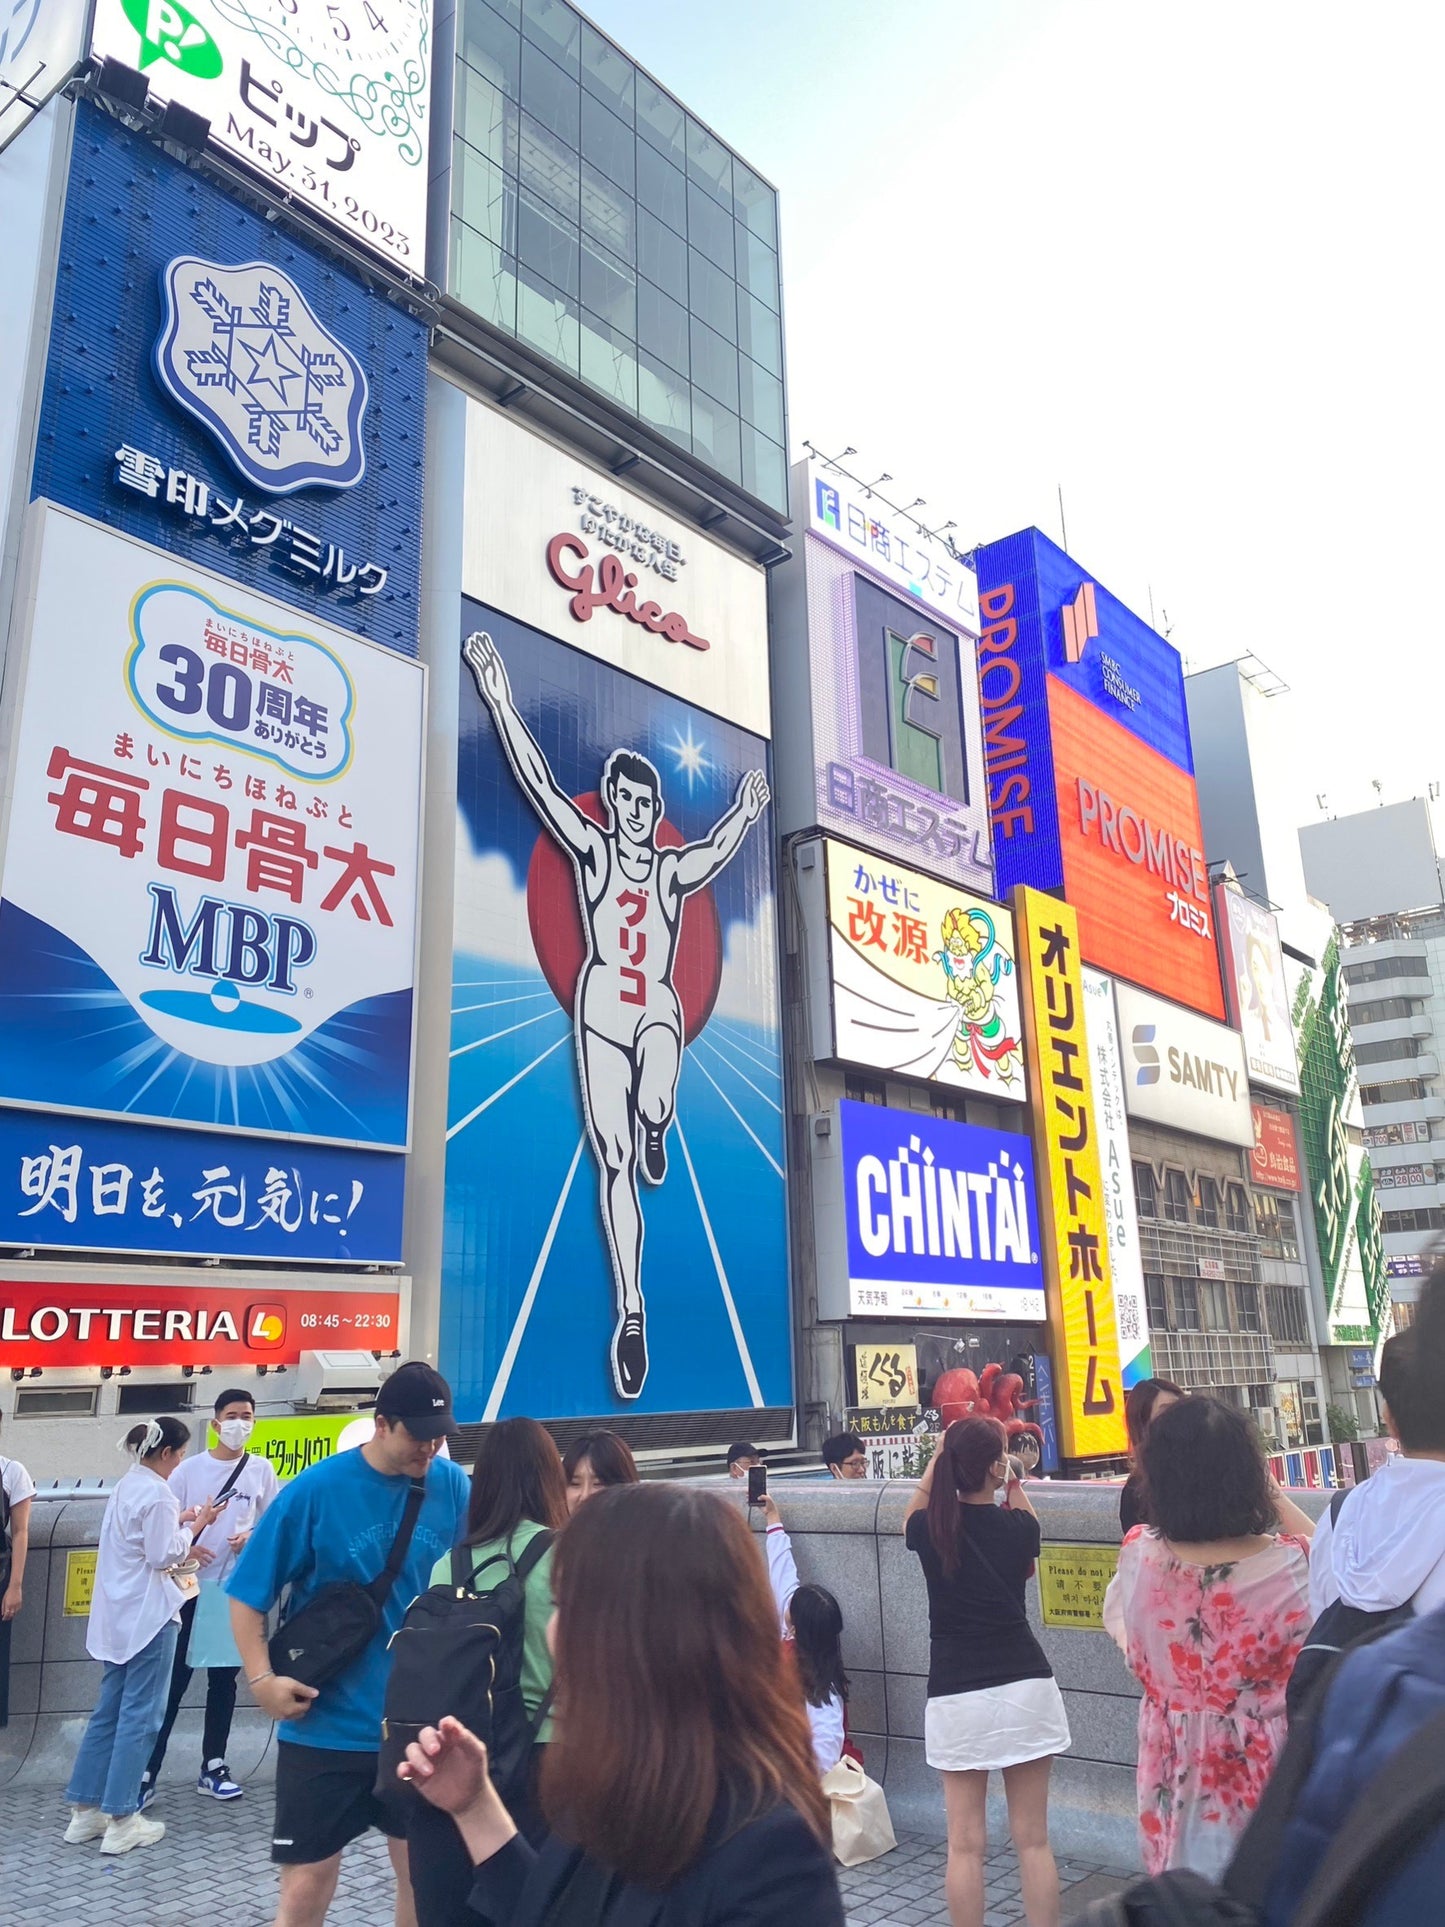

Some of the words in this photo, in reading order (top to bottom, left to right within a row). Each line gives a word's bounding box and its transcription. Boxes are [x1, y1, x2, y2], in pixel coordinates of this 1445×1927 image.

[239, 58, 362, 172] ピップ
[344, 195, 412, 257] 2023
[114, 443, 389, 595] 雪印メグミルク
[580, 513, 679, 583] ゆたかな人生
[546, 532, 711, 652] Glico
[203, 628, 295, 686] 毎日骨太
[205, 617, 295, 661] まいにちほねぶと
[1100, 650, 1122, 678] SMBC
[156, 643, 329, 738] 30周年
[978, 583, 1034, 840] PROMISE
[1102, 665, 1142, 706] CONSUMER
[1103, 678, 1136, 712] FINANCE
[253, 719, 329, 760] ありがとう
[113, 732, 354, 829] まいにちほねぶと
[46, 745, 396, 928] 毎日骨太
[826, 761, 995, 872] 日商エステム
[1075, 777, 1208, 904] PROMISE
[853, 864, 921, 912] かぜに
[1166, 890, 1212, 940] プロミス
[139, 882, 317, 996] MBP
[615, 886, 650, 1007] グリコ
[846, 896, 931, 966] 改源
[1168, 1045, 1239, 1102] SAMTY
[856, 1134, 1032, 1265] CHINTAI
[1039, 923, 1116, 1416] オリエントホーム
[1, 1305, 239, 1343] LOTTERIA
[868, 1352, 906, 1398] くくる
[849, 1414, 917, 1433] 大阪もんを食す
[1048, 1565, 1074, 1576] Please
[1078, 1566, 1087, 1576] do
[1090, 1569, 1103, 1577] not
